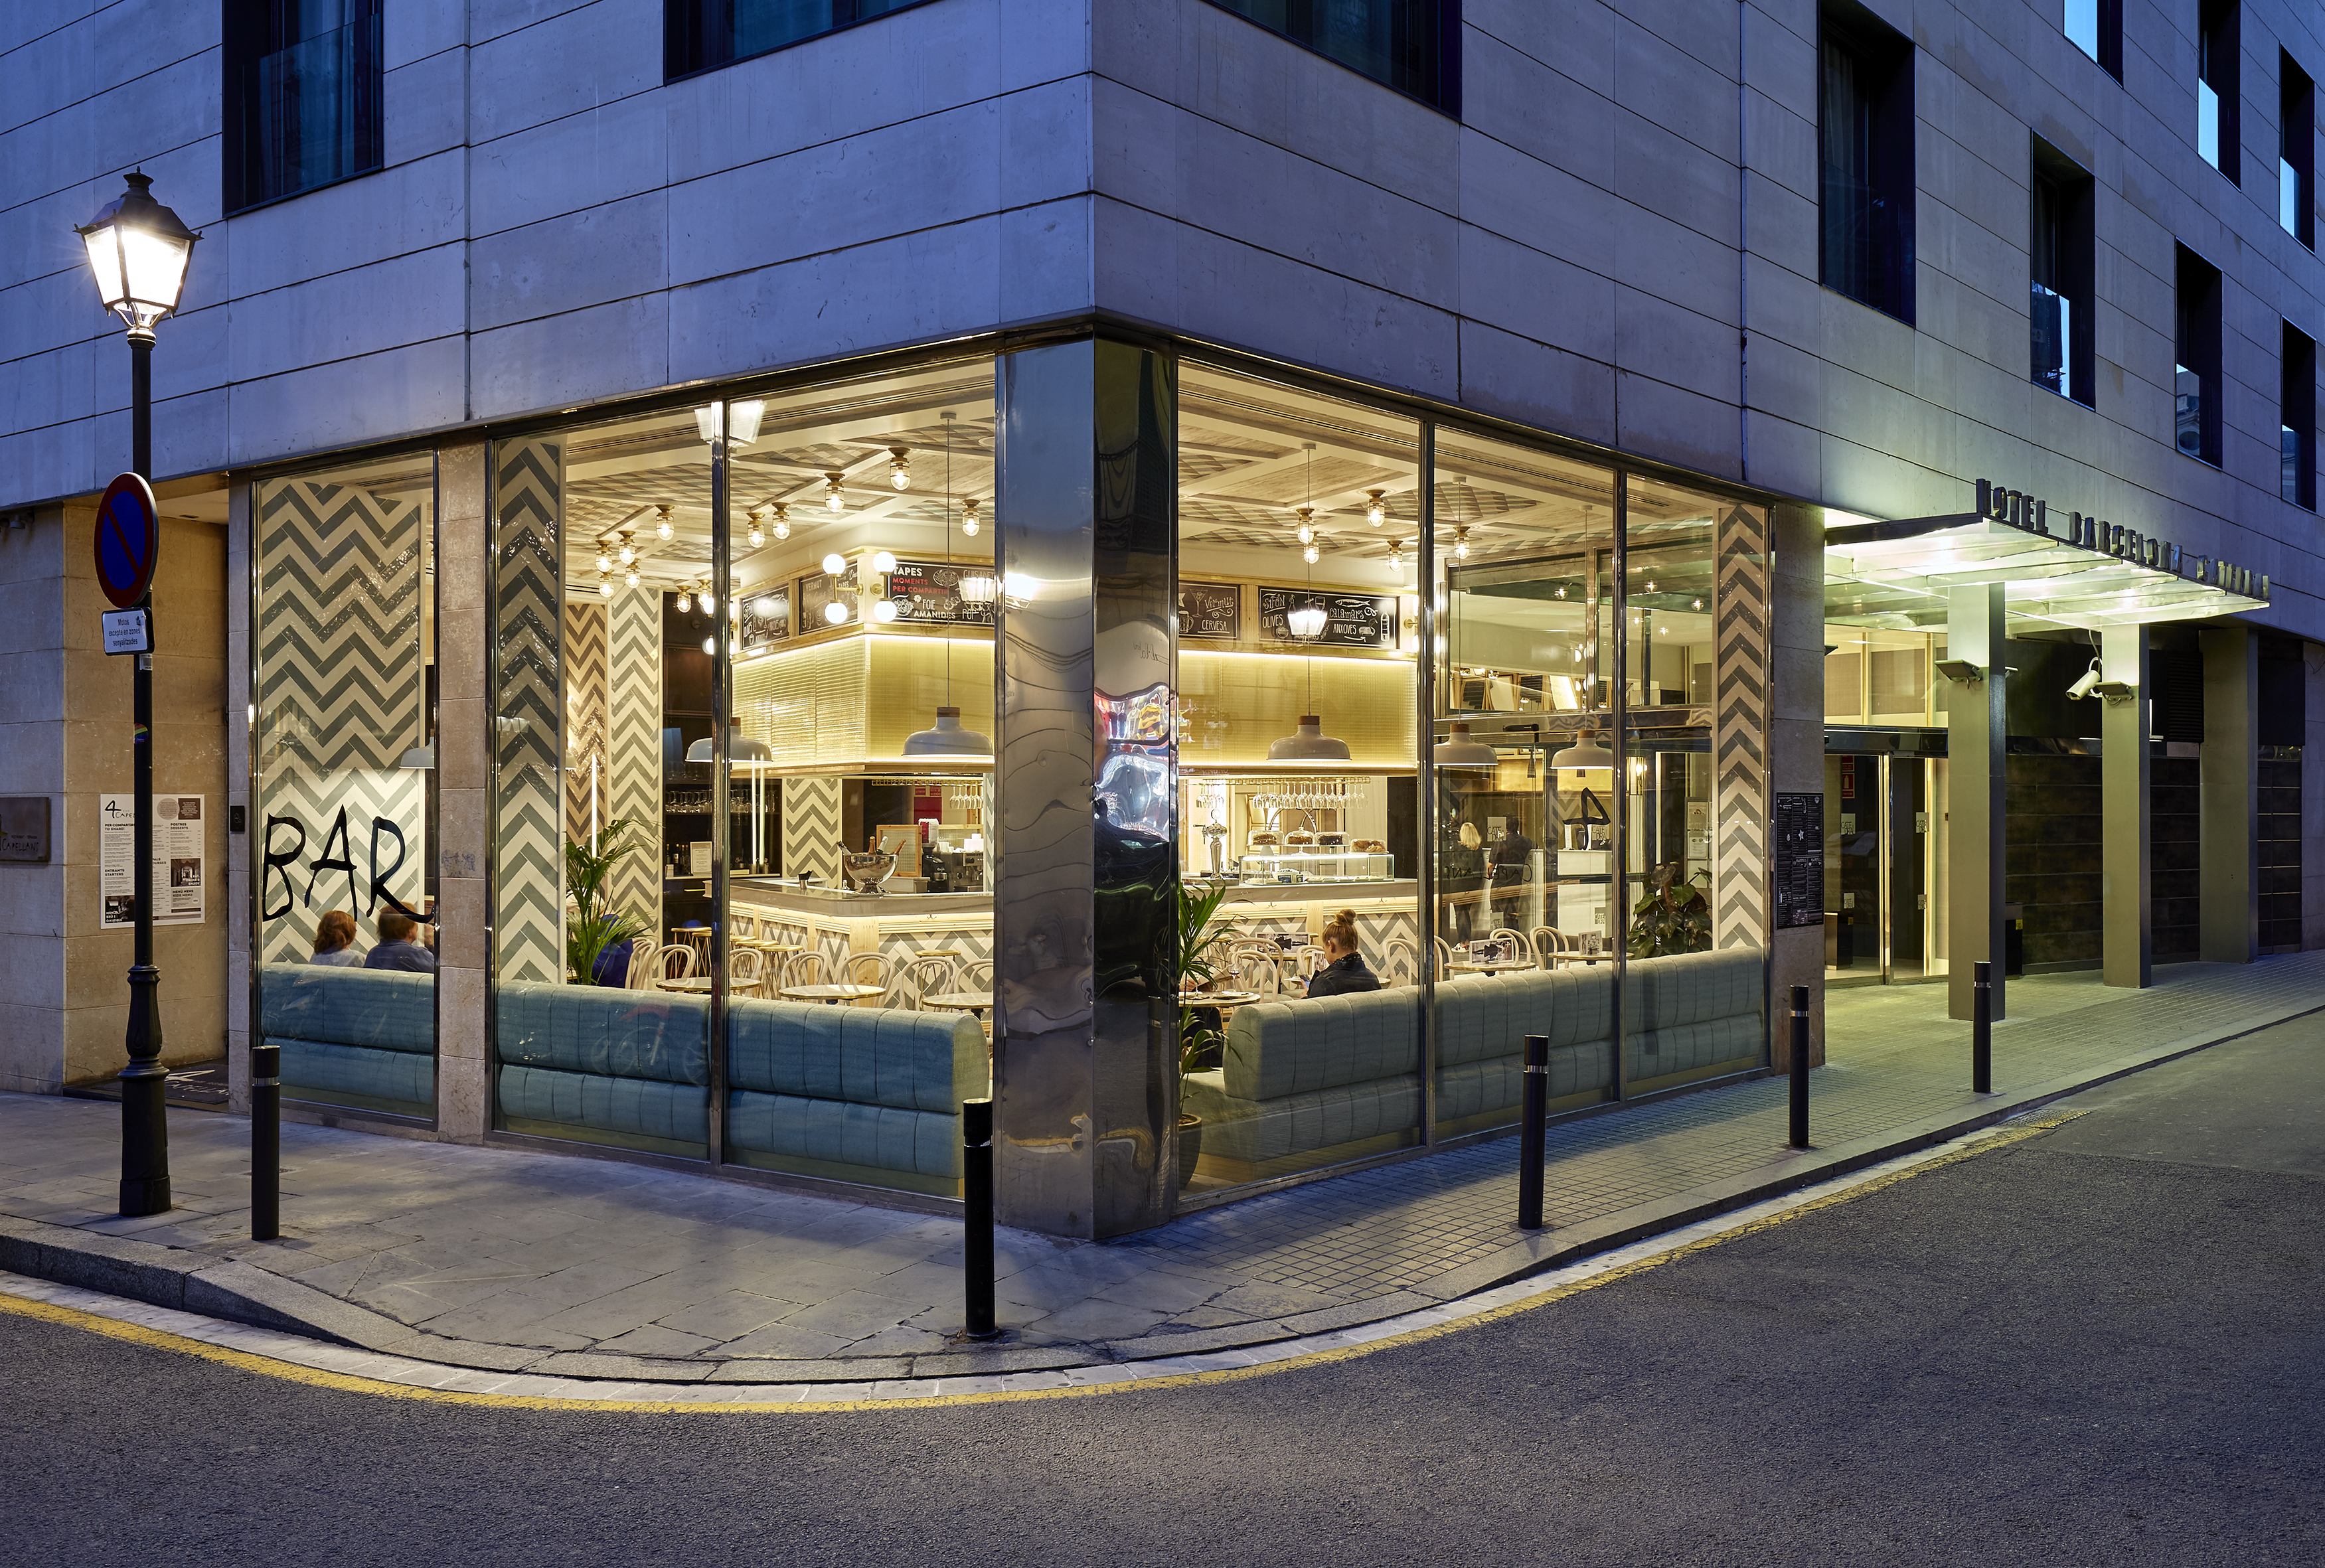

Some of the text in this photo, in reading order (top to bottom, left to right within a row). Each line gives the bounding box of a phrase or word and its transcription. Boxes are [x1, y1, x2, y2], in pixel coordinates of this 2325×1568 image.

[1976, 479, 2049, 534] HOTEL
[2069, 512, 2183, 574] BARCELONA
[893, 566, 923, 577] TAPES
[805, 579, 823, 592] VERMUT
[908, 586, 948, 595] COMPARTIR
[922, 599, 935, 610] FOIE
[914, 610, 956, 619] AMANIDES
[1202, 619, 1227, 631] CERVESA
[1262, 614, 1283, 629] OLIVES
[109, 629, 123, 637] excepte
[1332, 623, 1357, 635] ANXOVES
[113, 638, 138, 647] senyalitzades
[105, 800, 122, 819] 4
[262, 804, 435, 924] BAR
